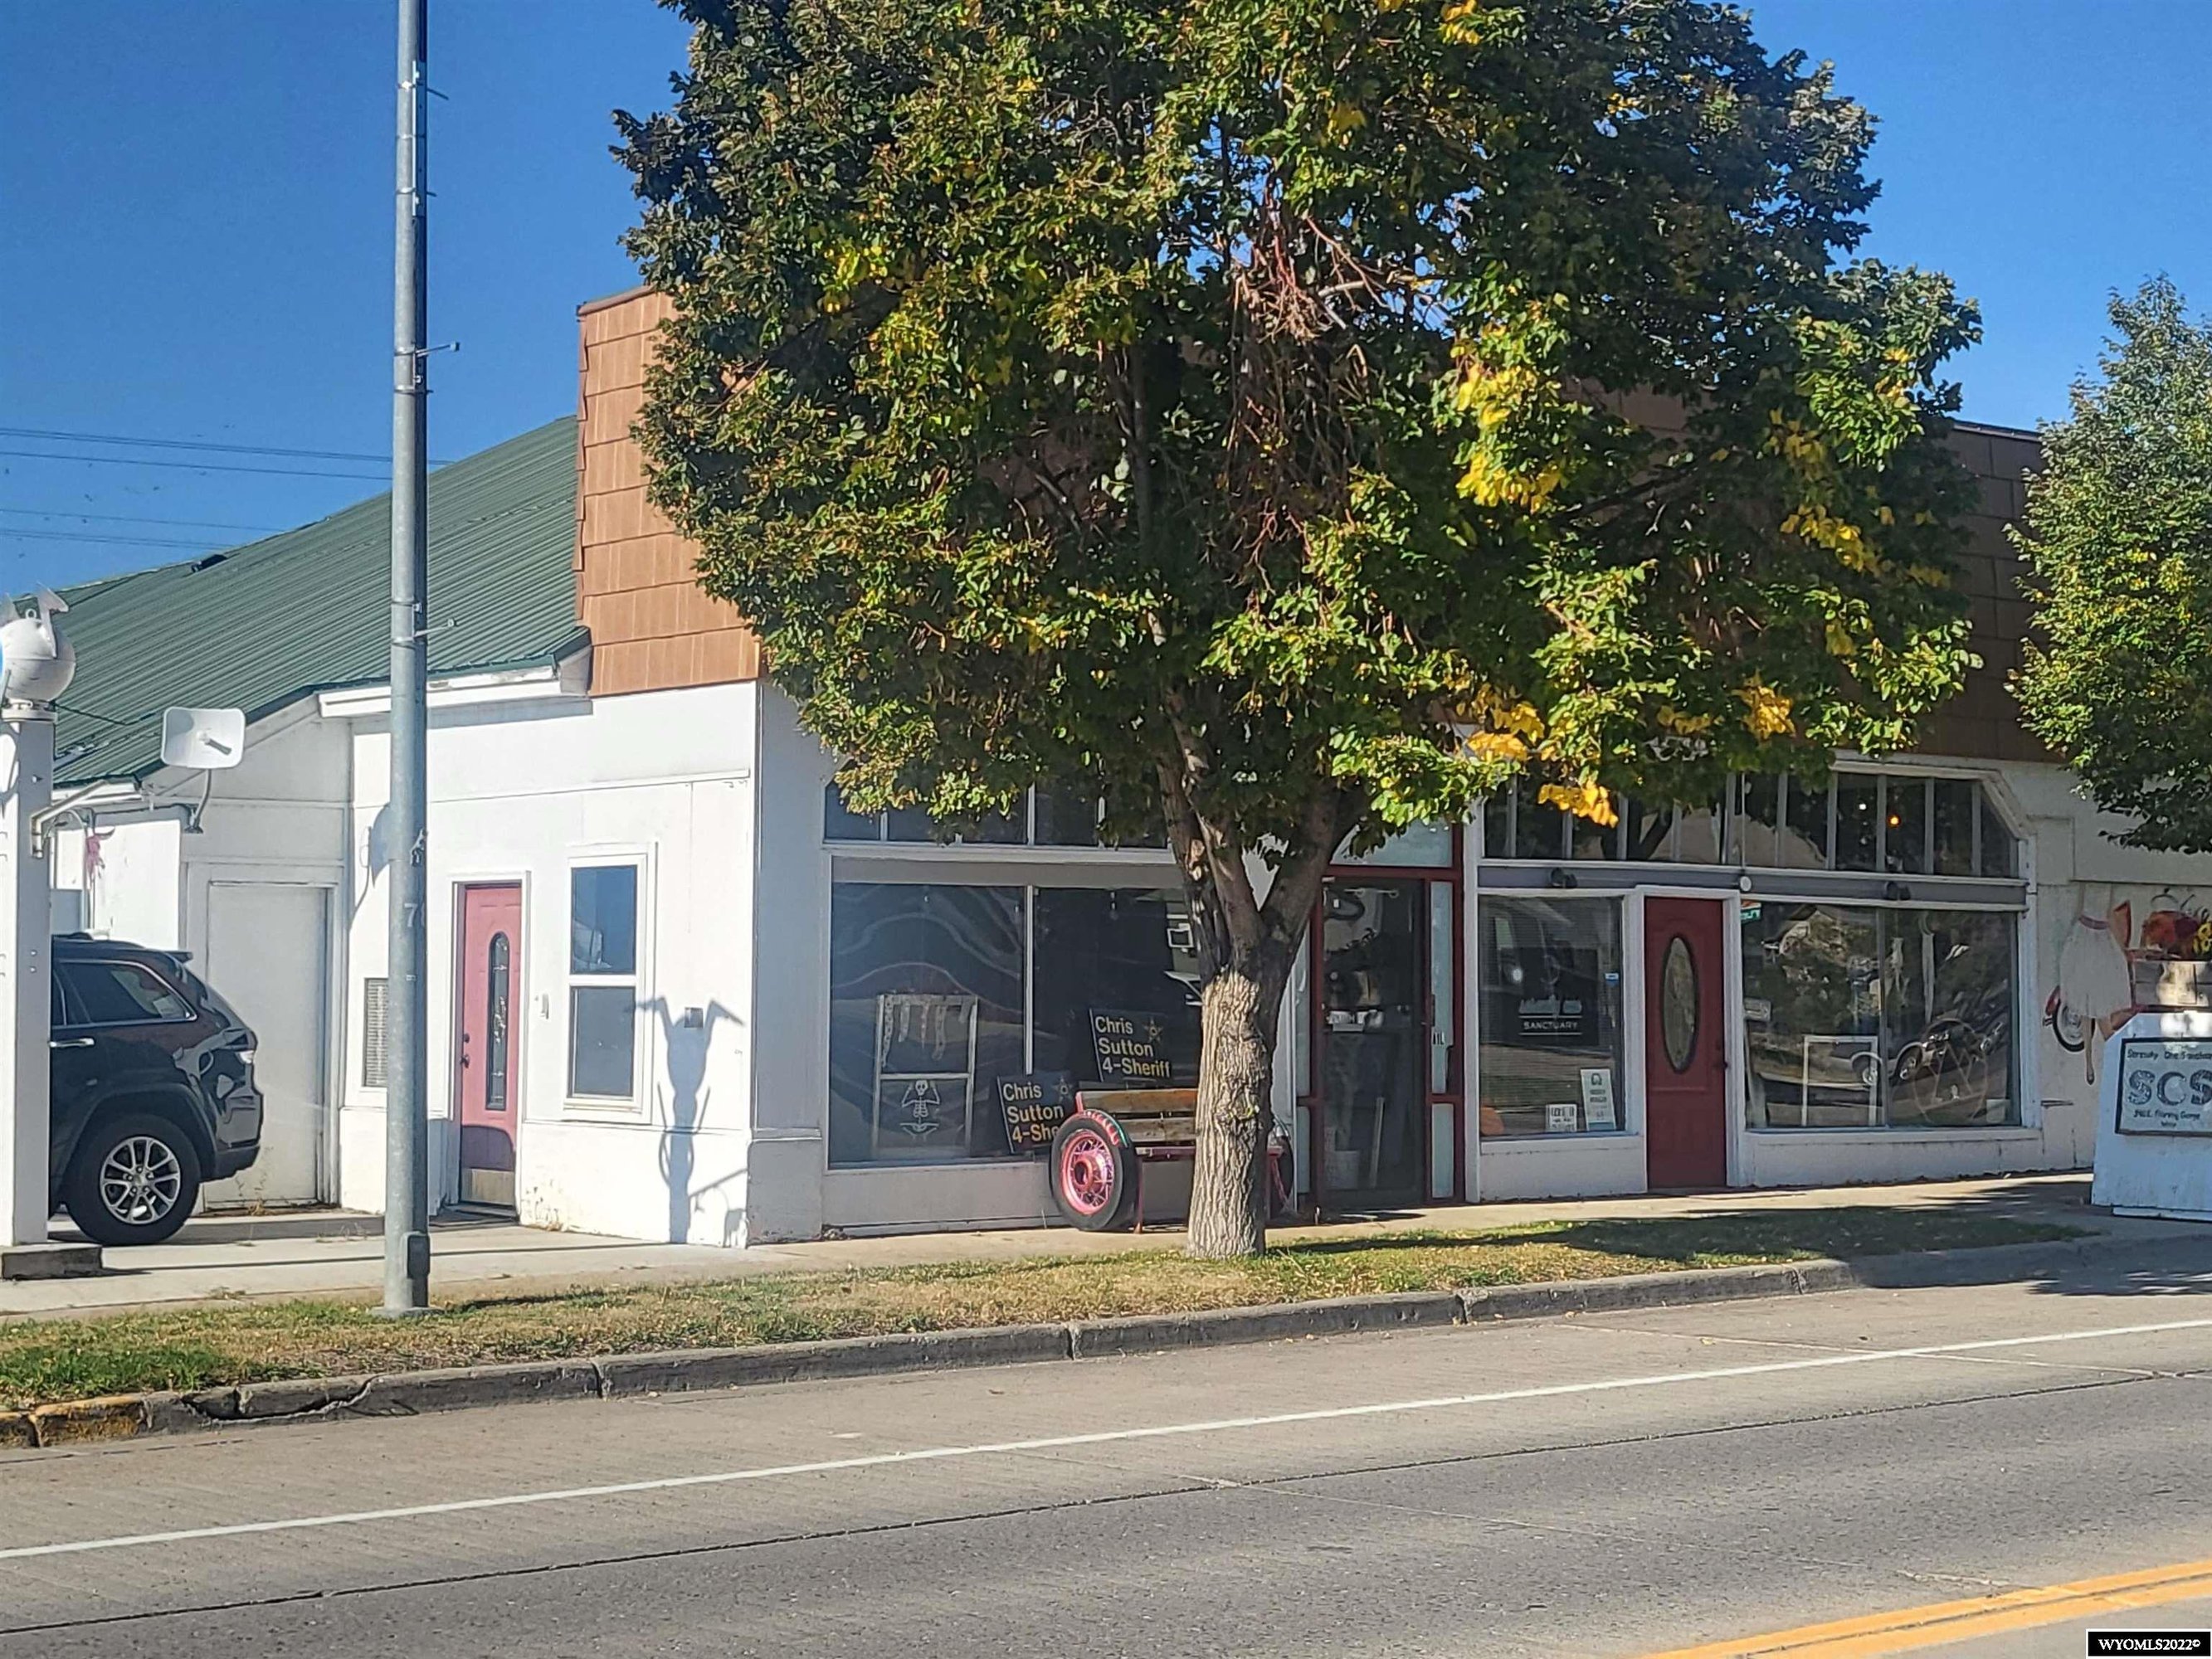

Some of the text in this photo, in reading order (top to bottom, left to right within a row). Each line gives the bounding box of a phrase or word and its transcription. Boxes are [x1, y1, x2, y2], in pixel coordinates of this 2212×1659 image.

[1094, 1016, 1133, 1034] Chris
[1523, 1021, 1578, 1029] SANCTUARY
[1099, 1038, 1153, 1058] Sutton
[1102, 1058, 1171, 1078] 4-Sheriff
[1002, 1083, 1042, 1102] Chris
[2127, 1069, 2212, 1107] SCS
[1006, 1105, 1065, 1125] Sutton
[1012, 1123, 1060, 1143] 4-She
